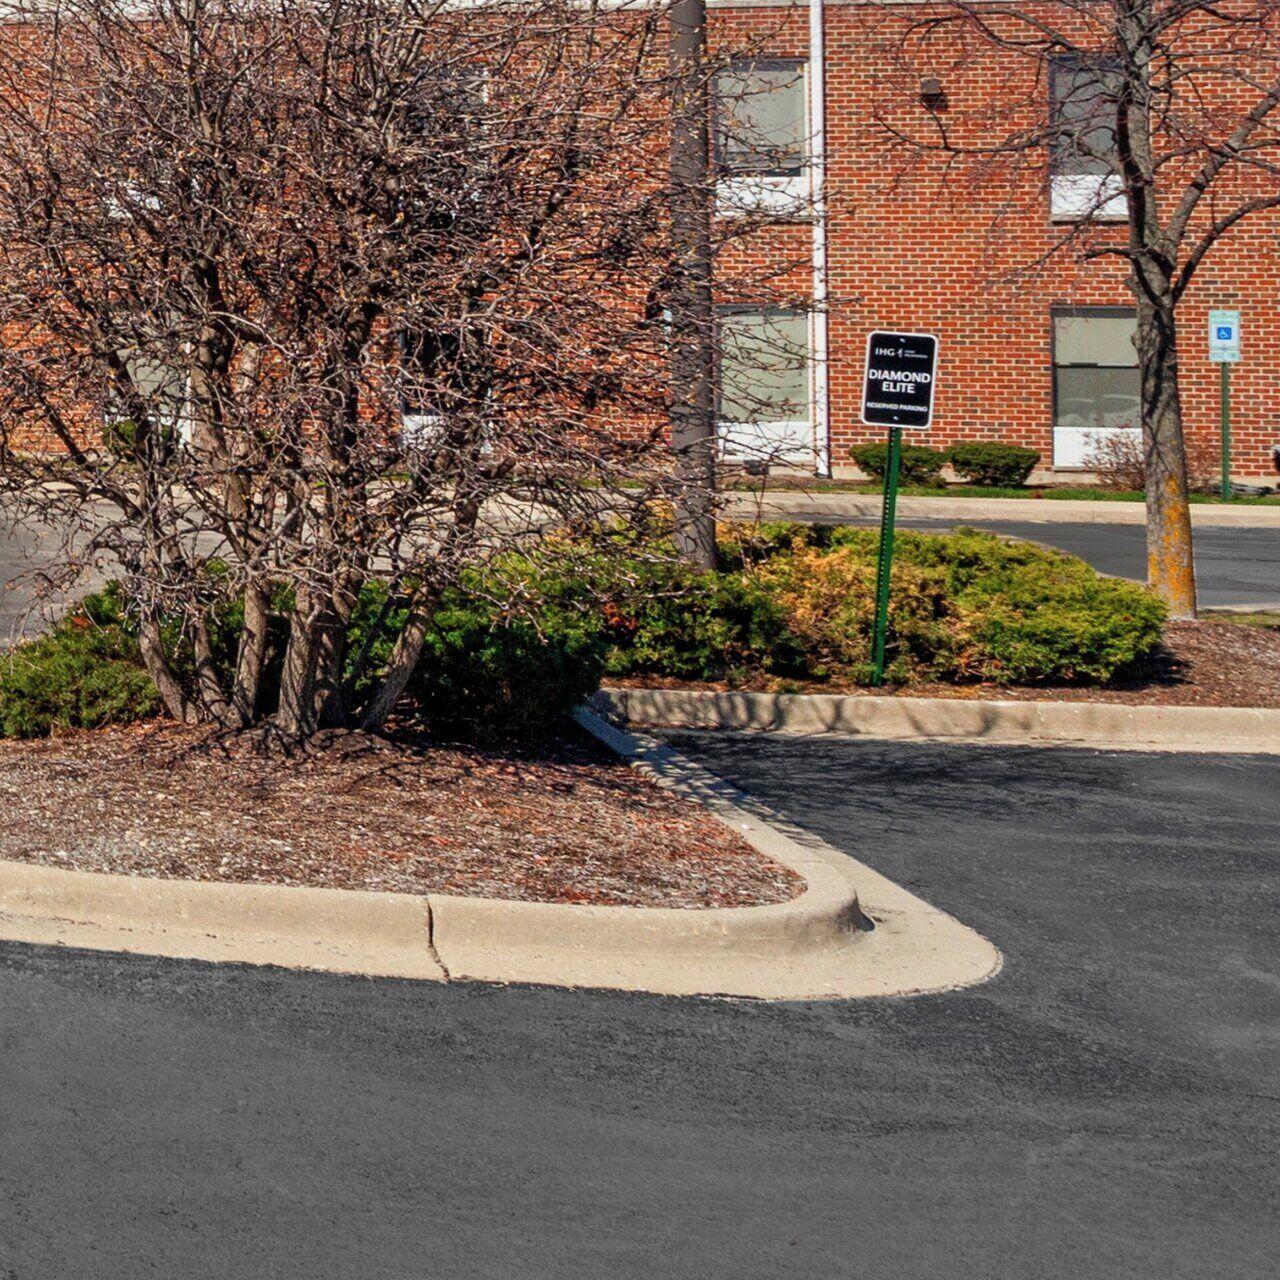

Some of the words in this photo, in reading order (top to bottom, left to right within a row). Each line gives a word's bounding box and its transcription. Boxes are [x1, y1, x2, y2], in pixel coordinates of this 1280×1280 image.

[875, 348, 895, 356] IHG
[868, 369, 931, 383] DIAMOND
[882, 381, 916, 394] ELITE
